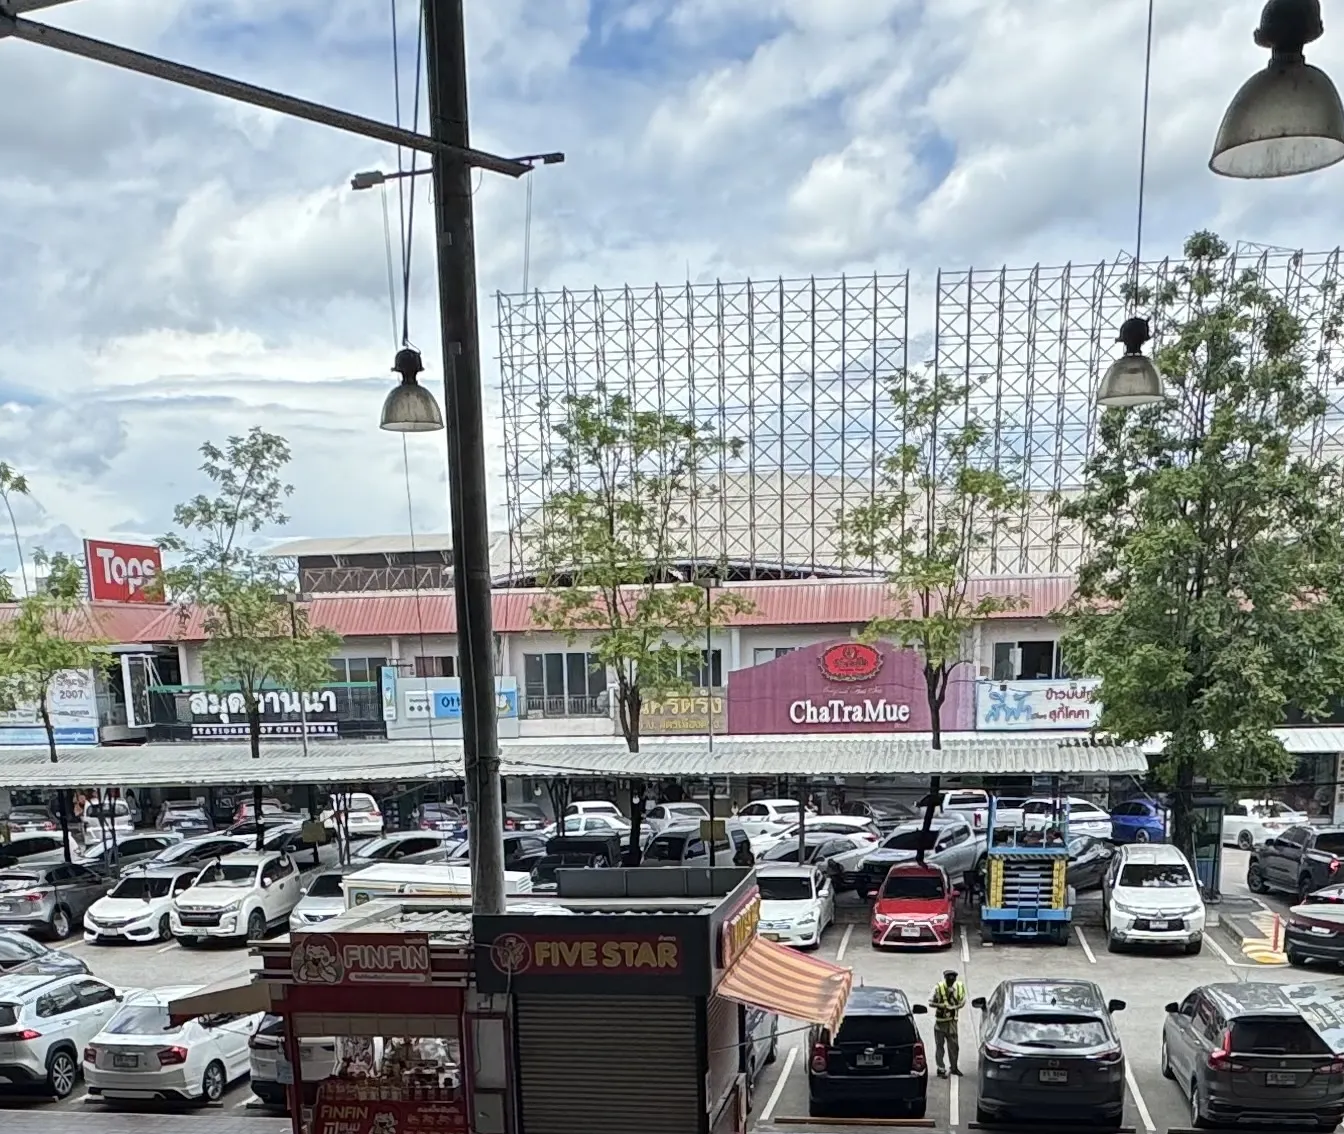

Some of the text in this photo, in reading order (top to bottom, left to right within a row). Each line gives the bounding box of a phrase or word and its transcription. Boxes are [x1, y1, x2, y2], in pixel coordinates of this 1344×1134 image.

[96, 547, 155, 595] Tops
[59, 690, 84, 700] 2007
[789, 699, 910, 724] ChaTraMue
[343, 944, 428, 970] FINFIN
[534, 942, 678, 968] FIVE STAR
[321, 1105, 369, 1120] FINFIN
